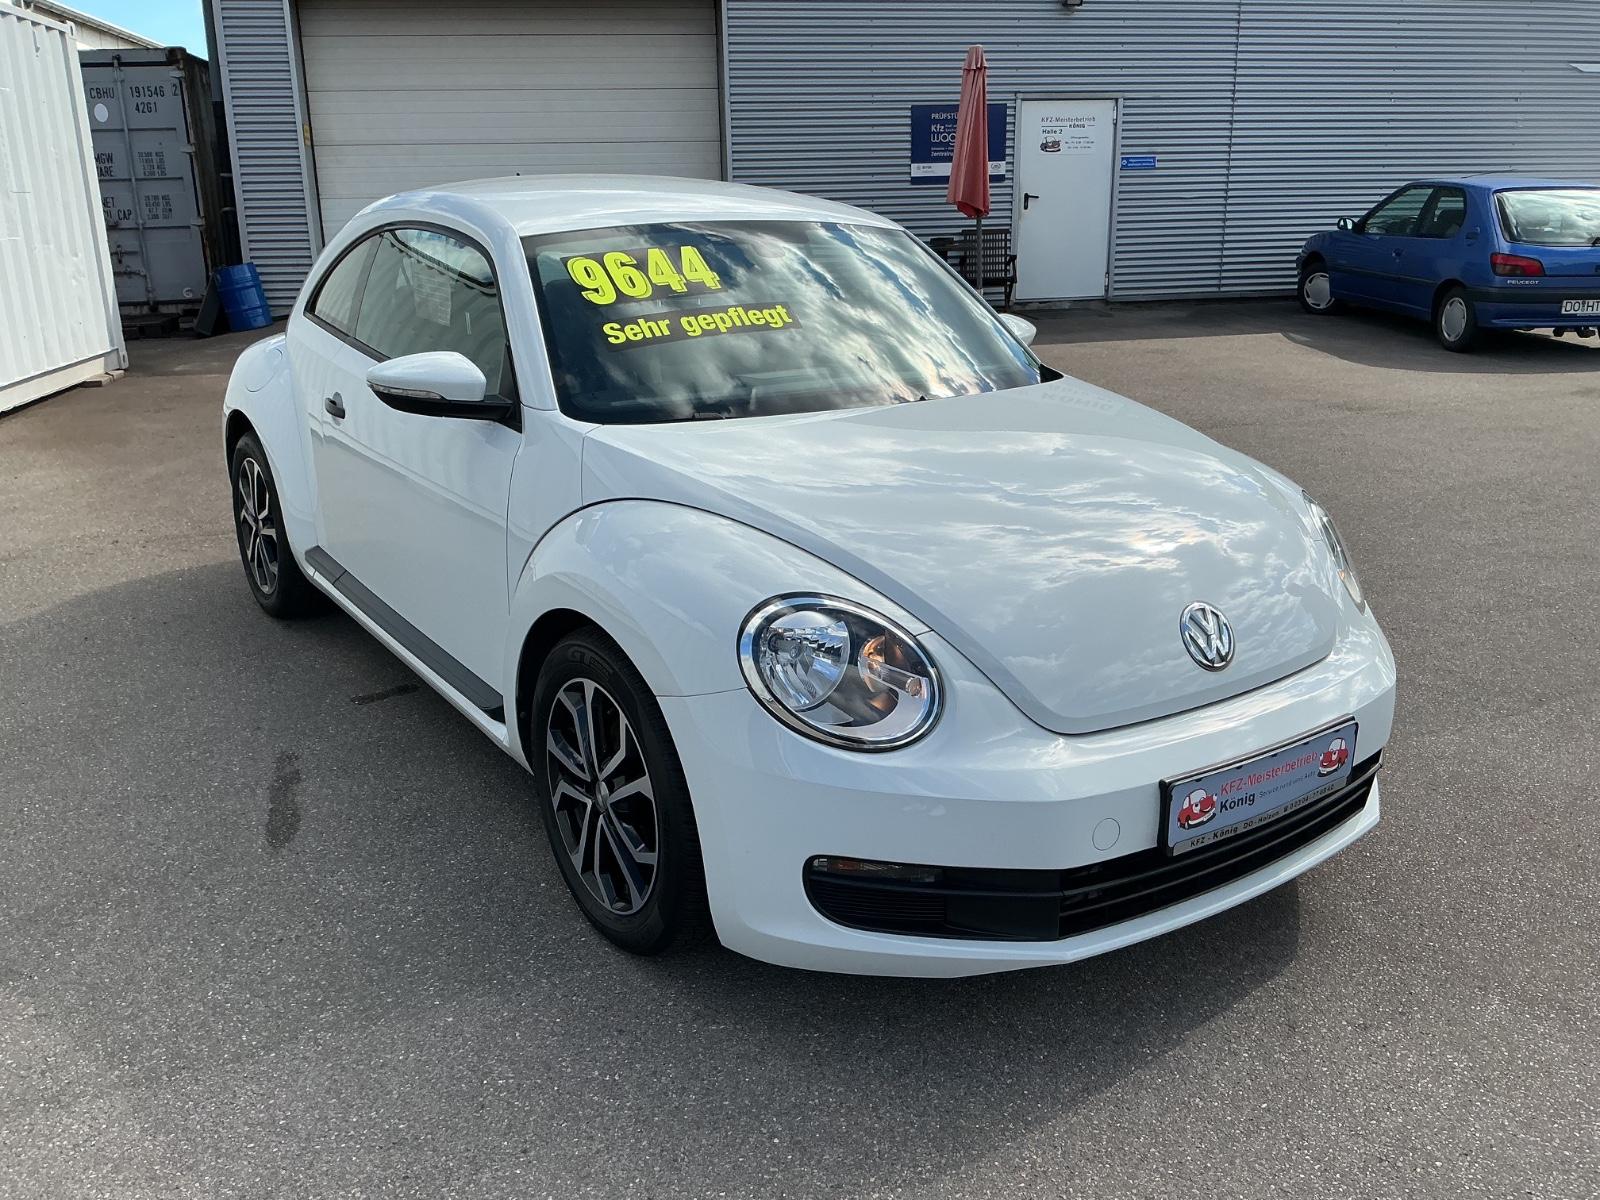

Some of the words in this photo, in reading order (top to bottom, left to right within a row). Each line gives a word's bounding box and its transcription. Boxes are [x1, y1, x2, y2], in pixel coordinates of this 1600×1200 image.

[89, 87, 115, 99] CBHU
[129, 85, 165, 98] 191546
[171, 83, 179, 96] 2
[135, 101, 158, 113] 42G1
[931, 124, 945, 133] Kfz
[118, 208, 132, 221] CAP
[567, 245, 722, 305] 9644
[1564, 301, 1581, 313] DO
[602, 318, 671, 345] Sehr
[680, 304, 793, 338] gepflegt
[1220, 751, 1318, 797] KFZ-Meisterbetrieb
[1220, 792, 1256, 814] König
